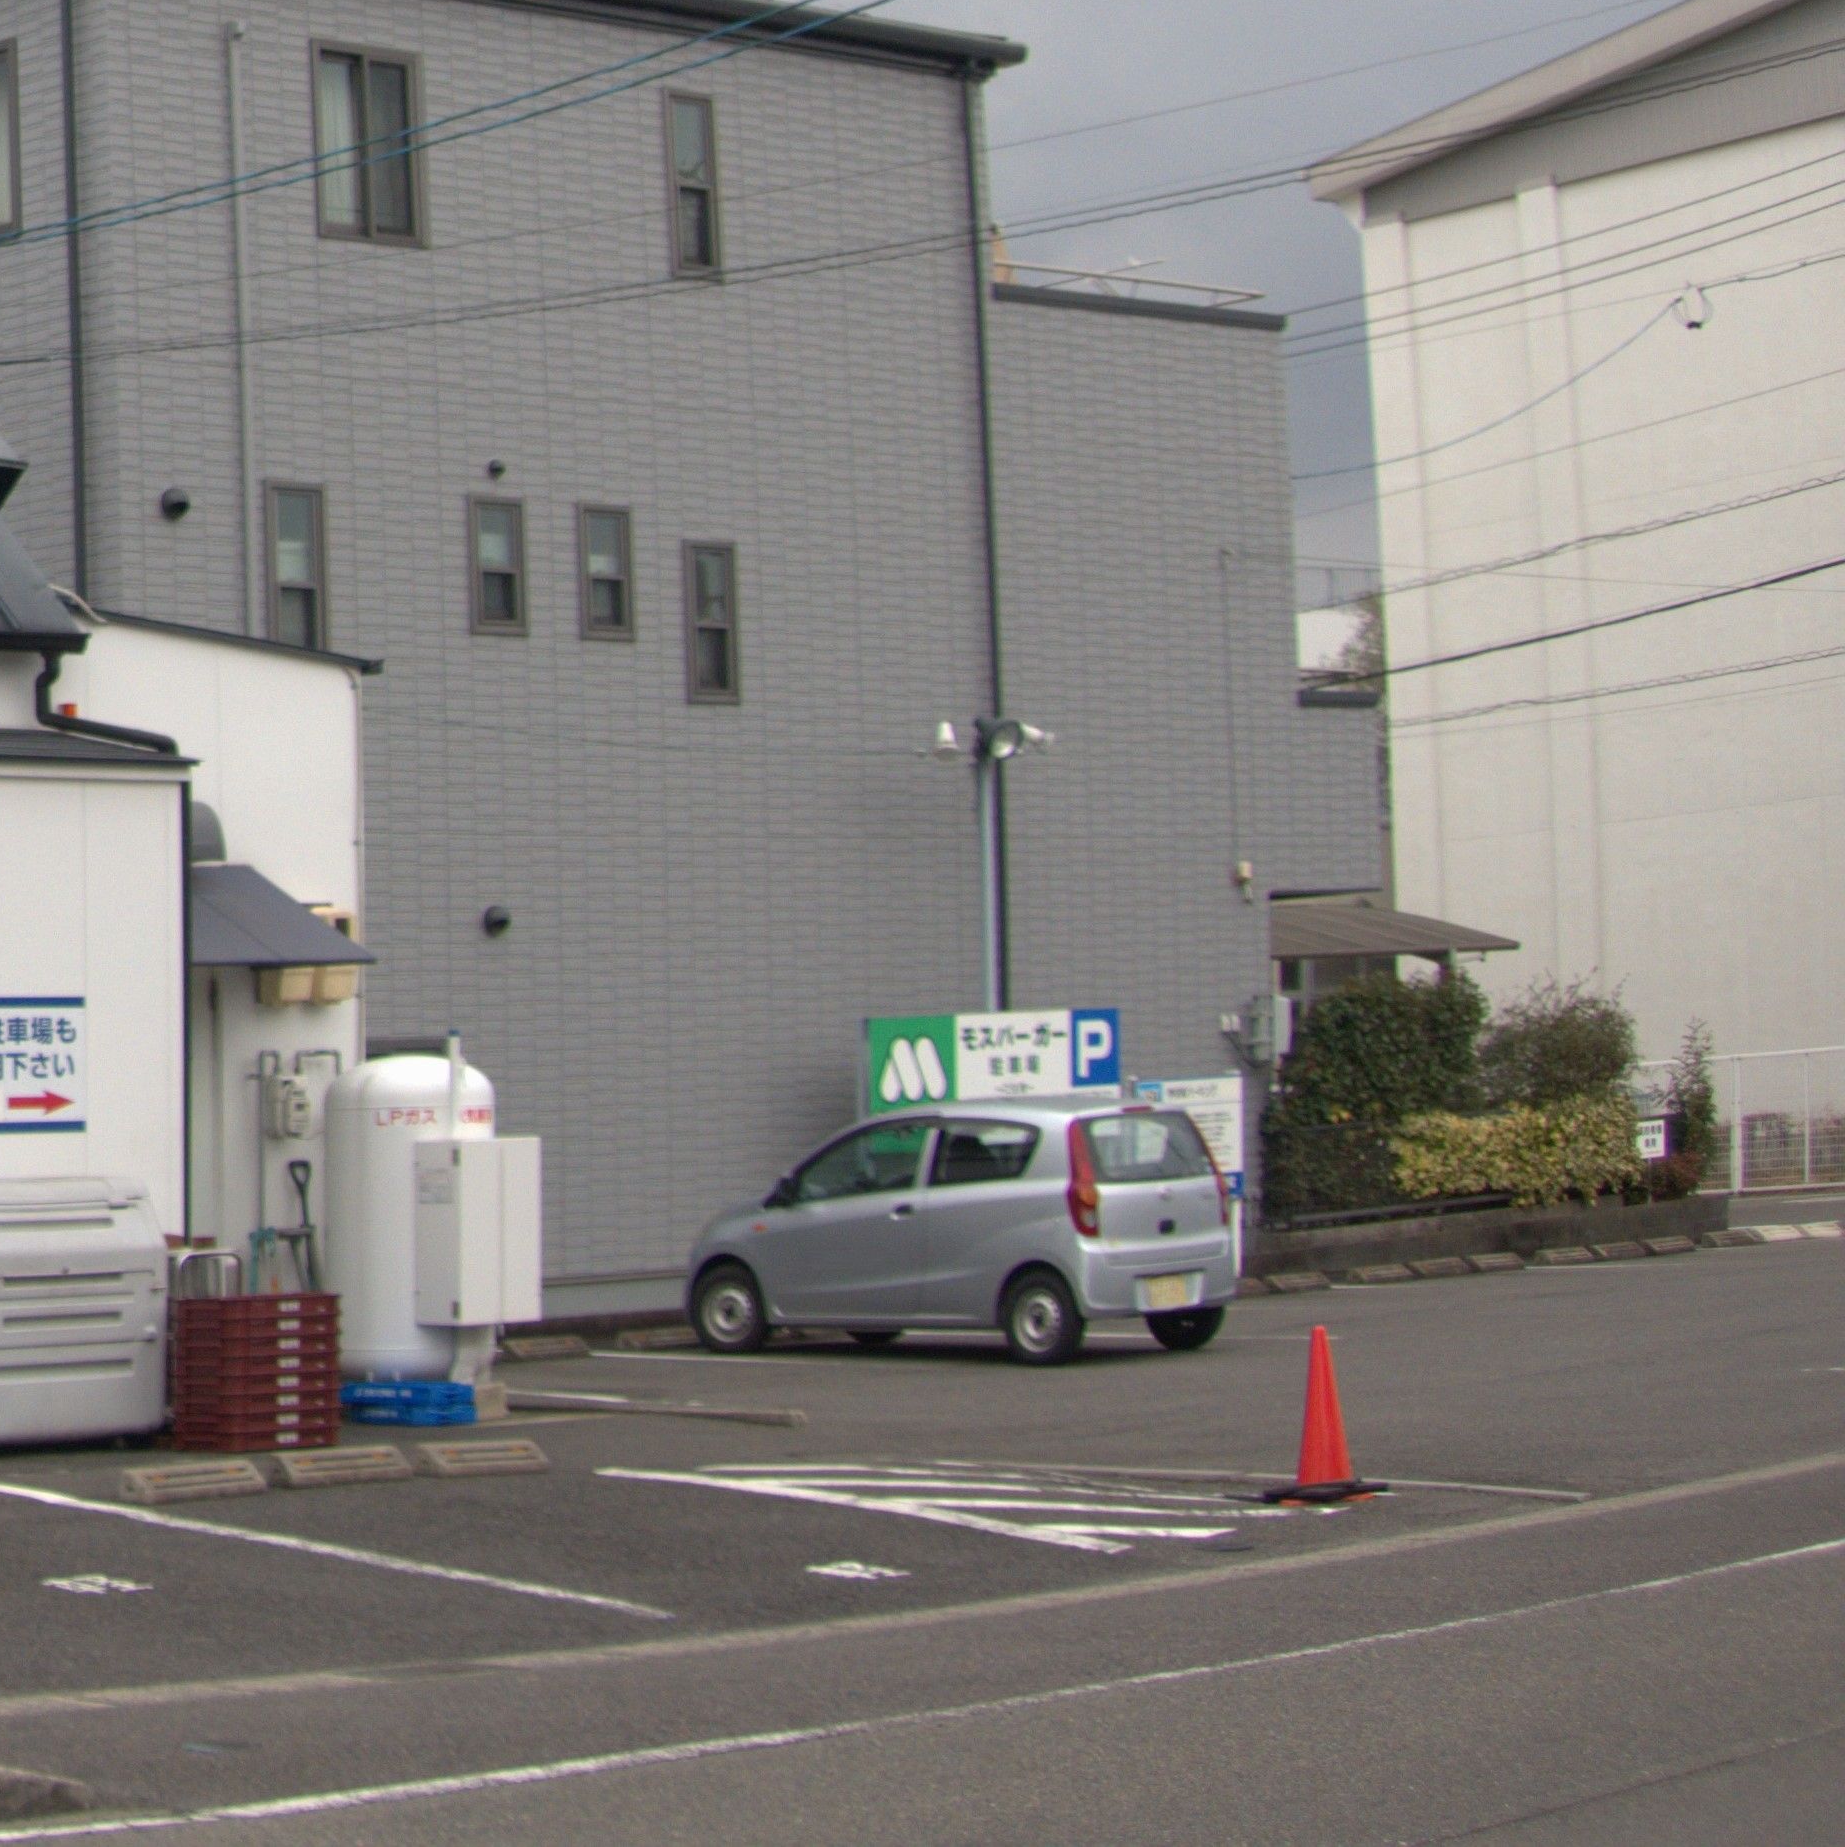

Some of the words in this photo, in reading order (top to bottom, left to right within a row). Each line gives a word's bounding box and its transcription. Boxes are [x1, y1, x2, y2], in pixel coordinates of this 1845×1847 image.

[960, 1024, 1067, 1050] モスバーガー
[1076, 1019, 1113, 1079] P
